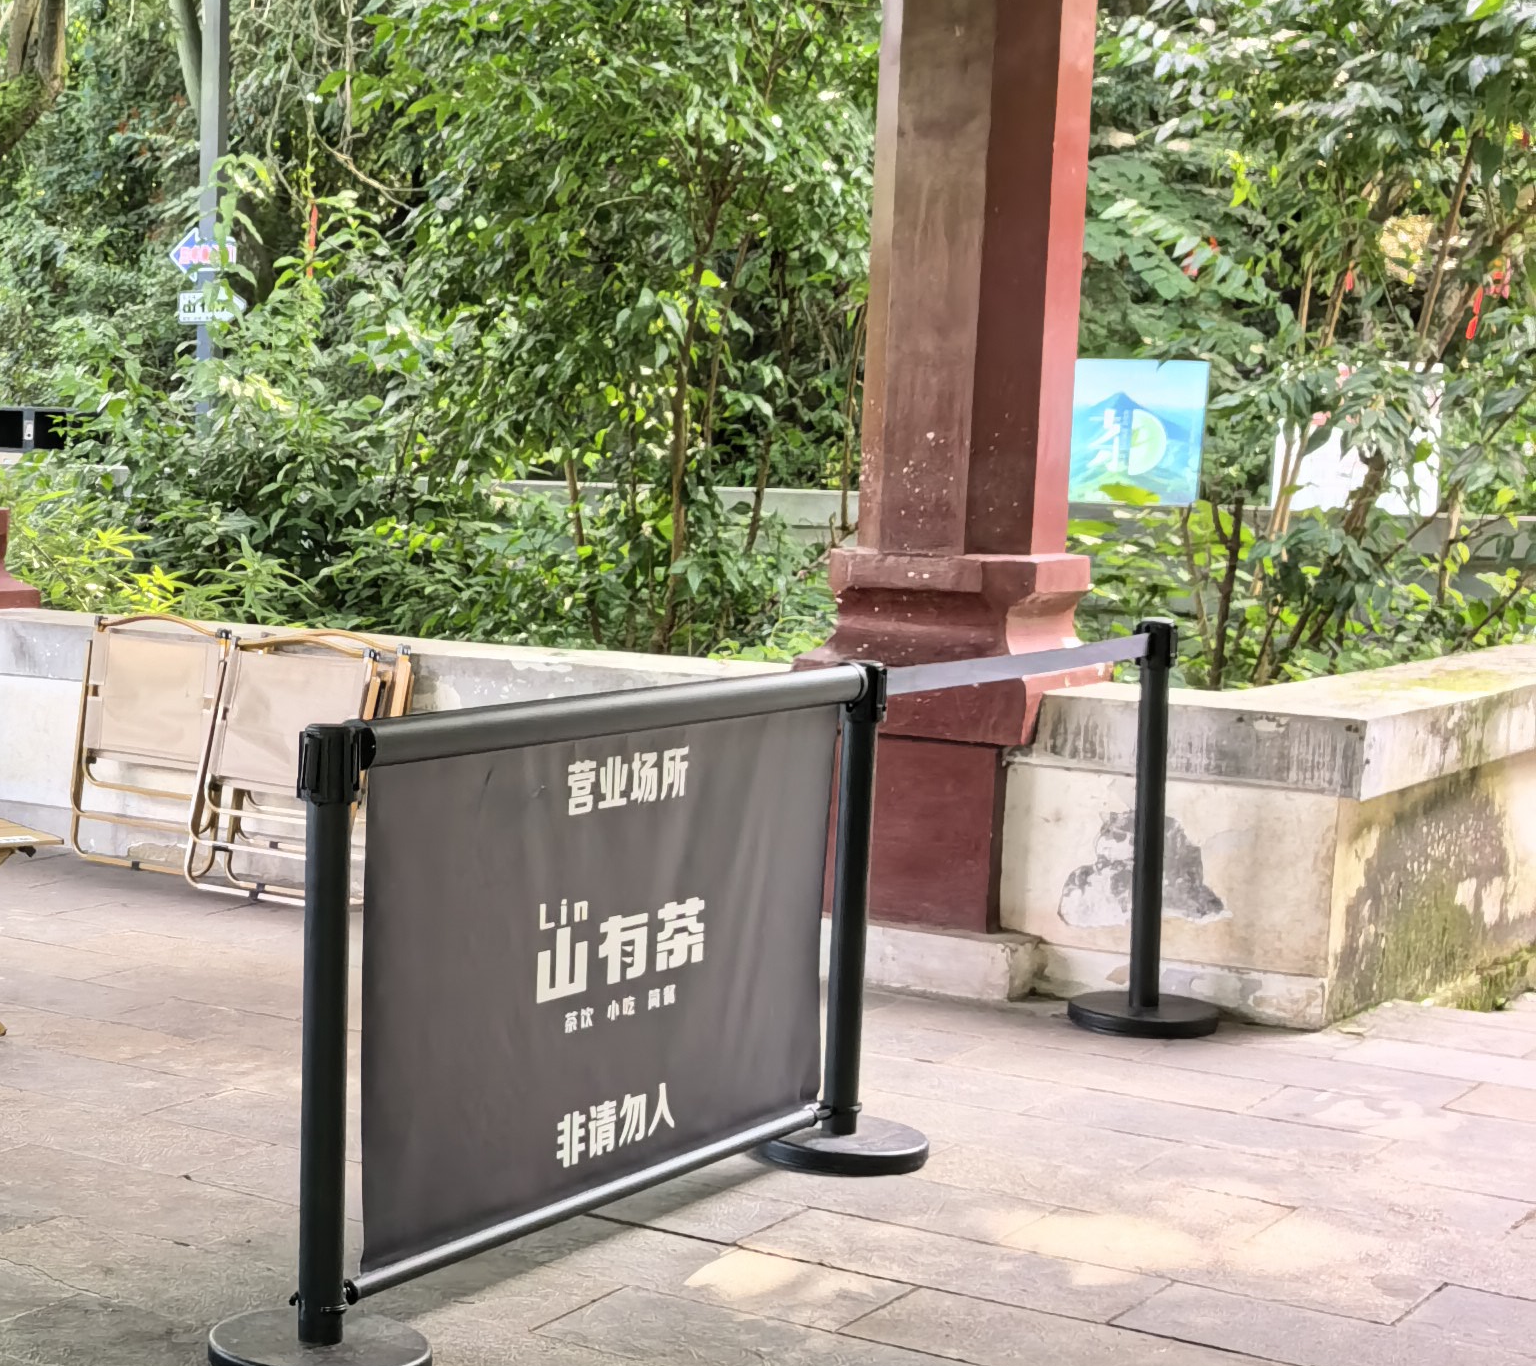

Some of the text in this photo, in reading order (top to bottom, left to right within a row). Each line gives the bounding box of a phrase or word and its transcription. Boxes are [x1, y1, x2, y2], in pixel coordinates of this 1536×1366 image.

[568, 744, 690, 816] 营业场所
[539, 899, 589, 931] Lin
[536, 897, 705, 1004] 山有茶
[564, 1006, 595, 1034] 茶饮
[607, 995, 637, 1022] 小吃
